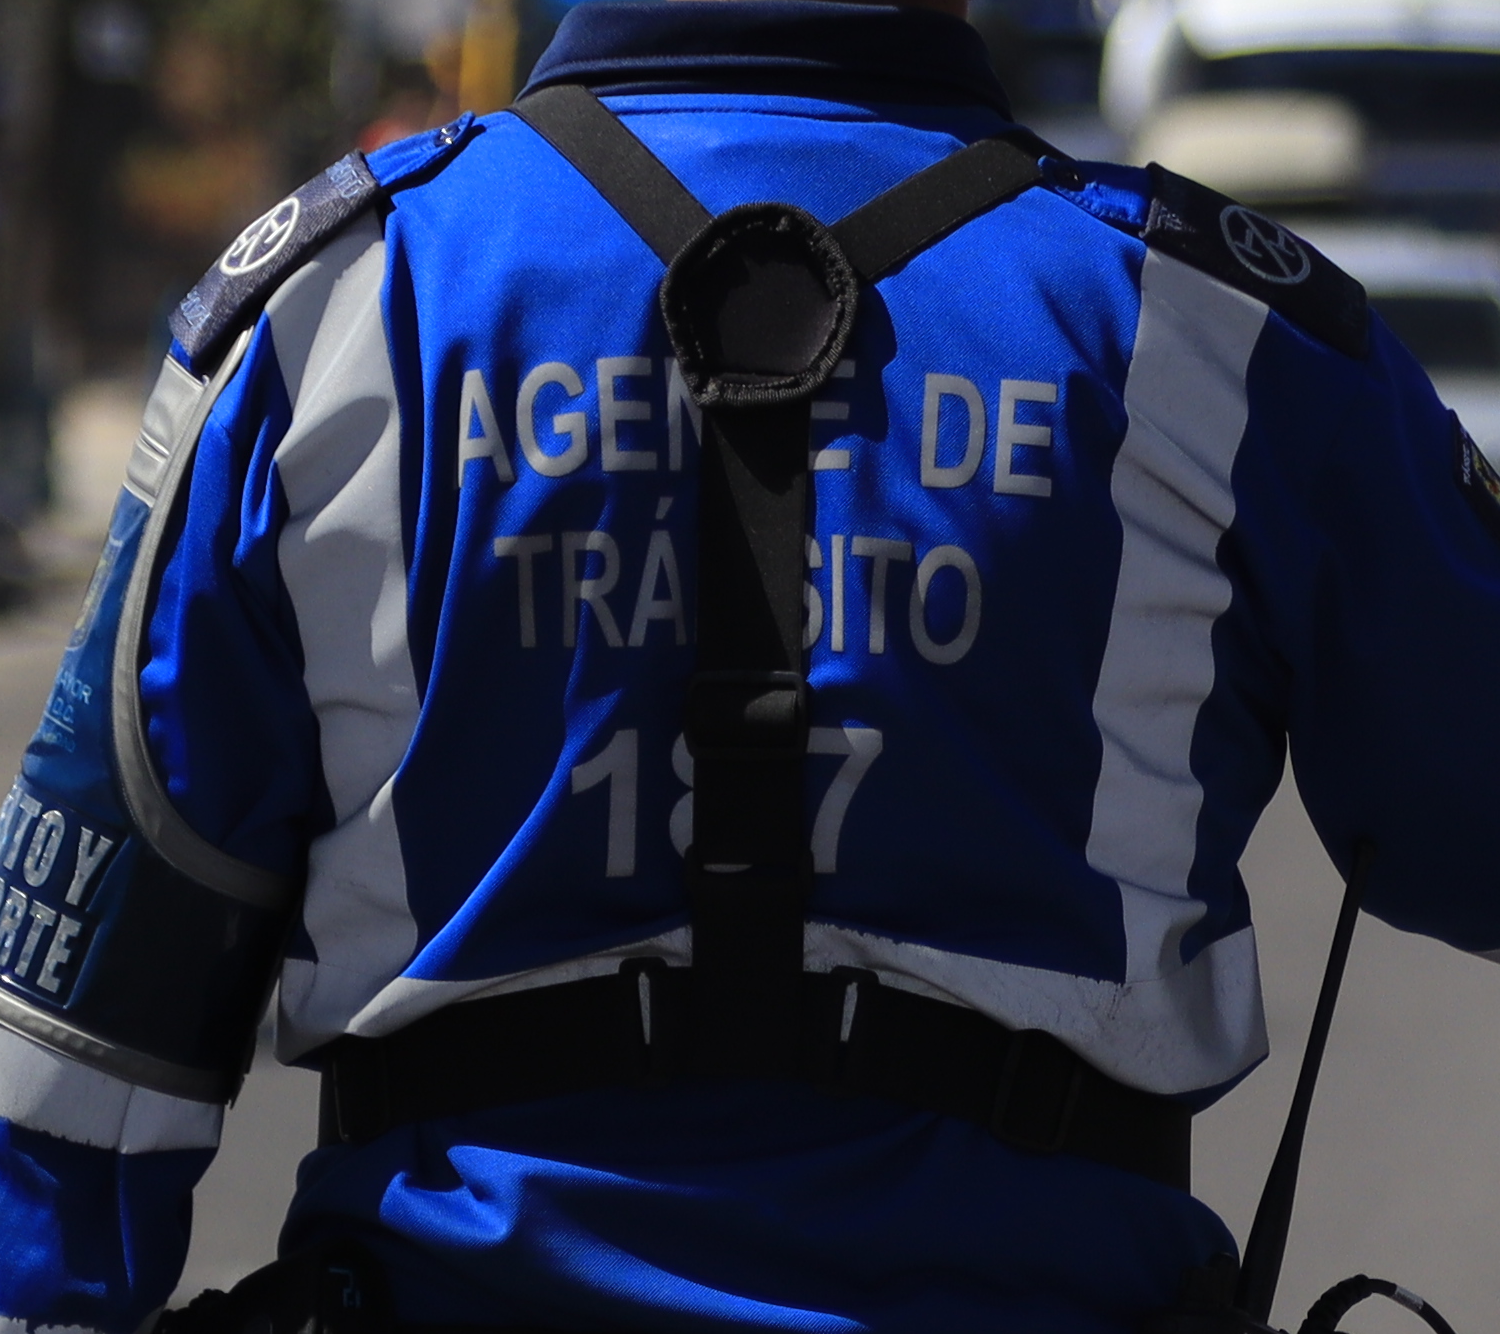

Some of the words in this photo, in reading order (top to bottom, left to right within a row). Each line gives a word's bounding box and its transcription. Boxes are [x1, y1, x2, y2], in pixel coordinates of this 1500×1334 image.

[457, 356, 856, 489] AGENE
[920, 373, 1058, 498] DE
[493, 496, 983, 666] TRÁITO
[66, 826, 113, 906] Y
